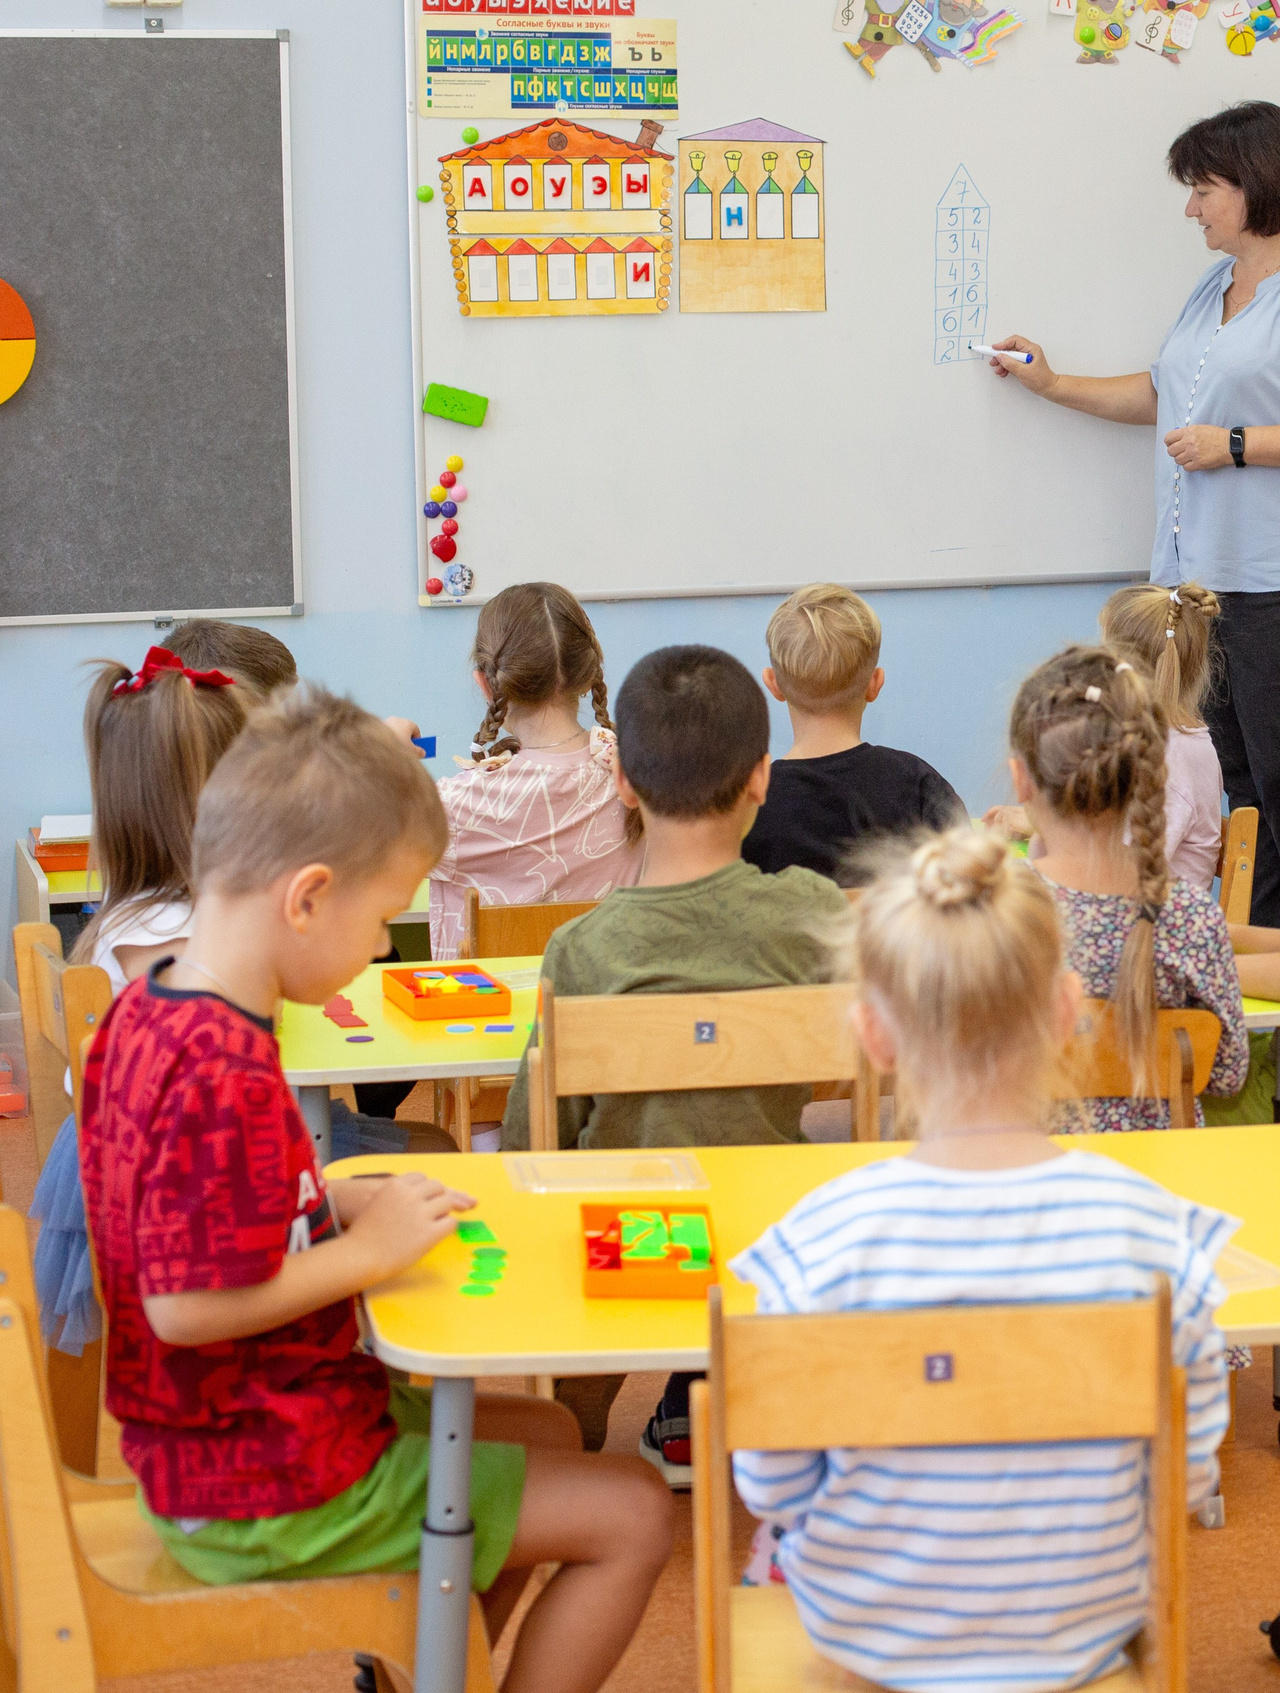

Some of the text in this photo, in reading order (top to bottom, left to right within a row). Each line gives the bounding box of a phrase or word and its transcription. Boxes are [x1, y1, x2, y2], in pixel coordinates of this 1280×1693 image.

[496, 18, 544, 28] Согласные
[546, 19, 574, 30] буквы
[585, 21, 611, 30] звуки
[429, 39, 611, 65] й н м л р б в г д з ж
[628, 47, 662, 62] Ъ Ь
[513, 81, 525, 96] п
[527, 75, 543, 101] ф
[546, 81, 558, 96] к
[563, 81, 574, 96] т
[580, 81, 590, 97] с
[594, 82, 611, 97] ш
[614, 82, 626, 97] х
[631, 82, 644, 100] ц
[647, 82, 659, 97] ч
[467, 173, 648, 198] А О У Э Ы
[955, 180, 970, 204] 7
[725, 206, 743, 227] Н
[947, 207, 982, 226] 5 2
[949, 232, 980, 254] 3 4
[632, 261, 651, 283] И
[949, 262, 980, 281] 4 3
[949, 284, 978, 304] 1 6
[942, 306, 980, 333] 6 1
[940, 340, 955, 362] 2
[701, 1026, 711, 1040] 2
